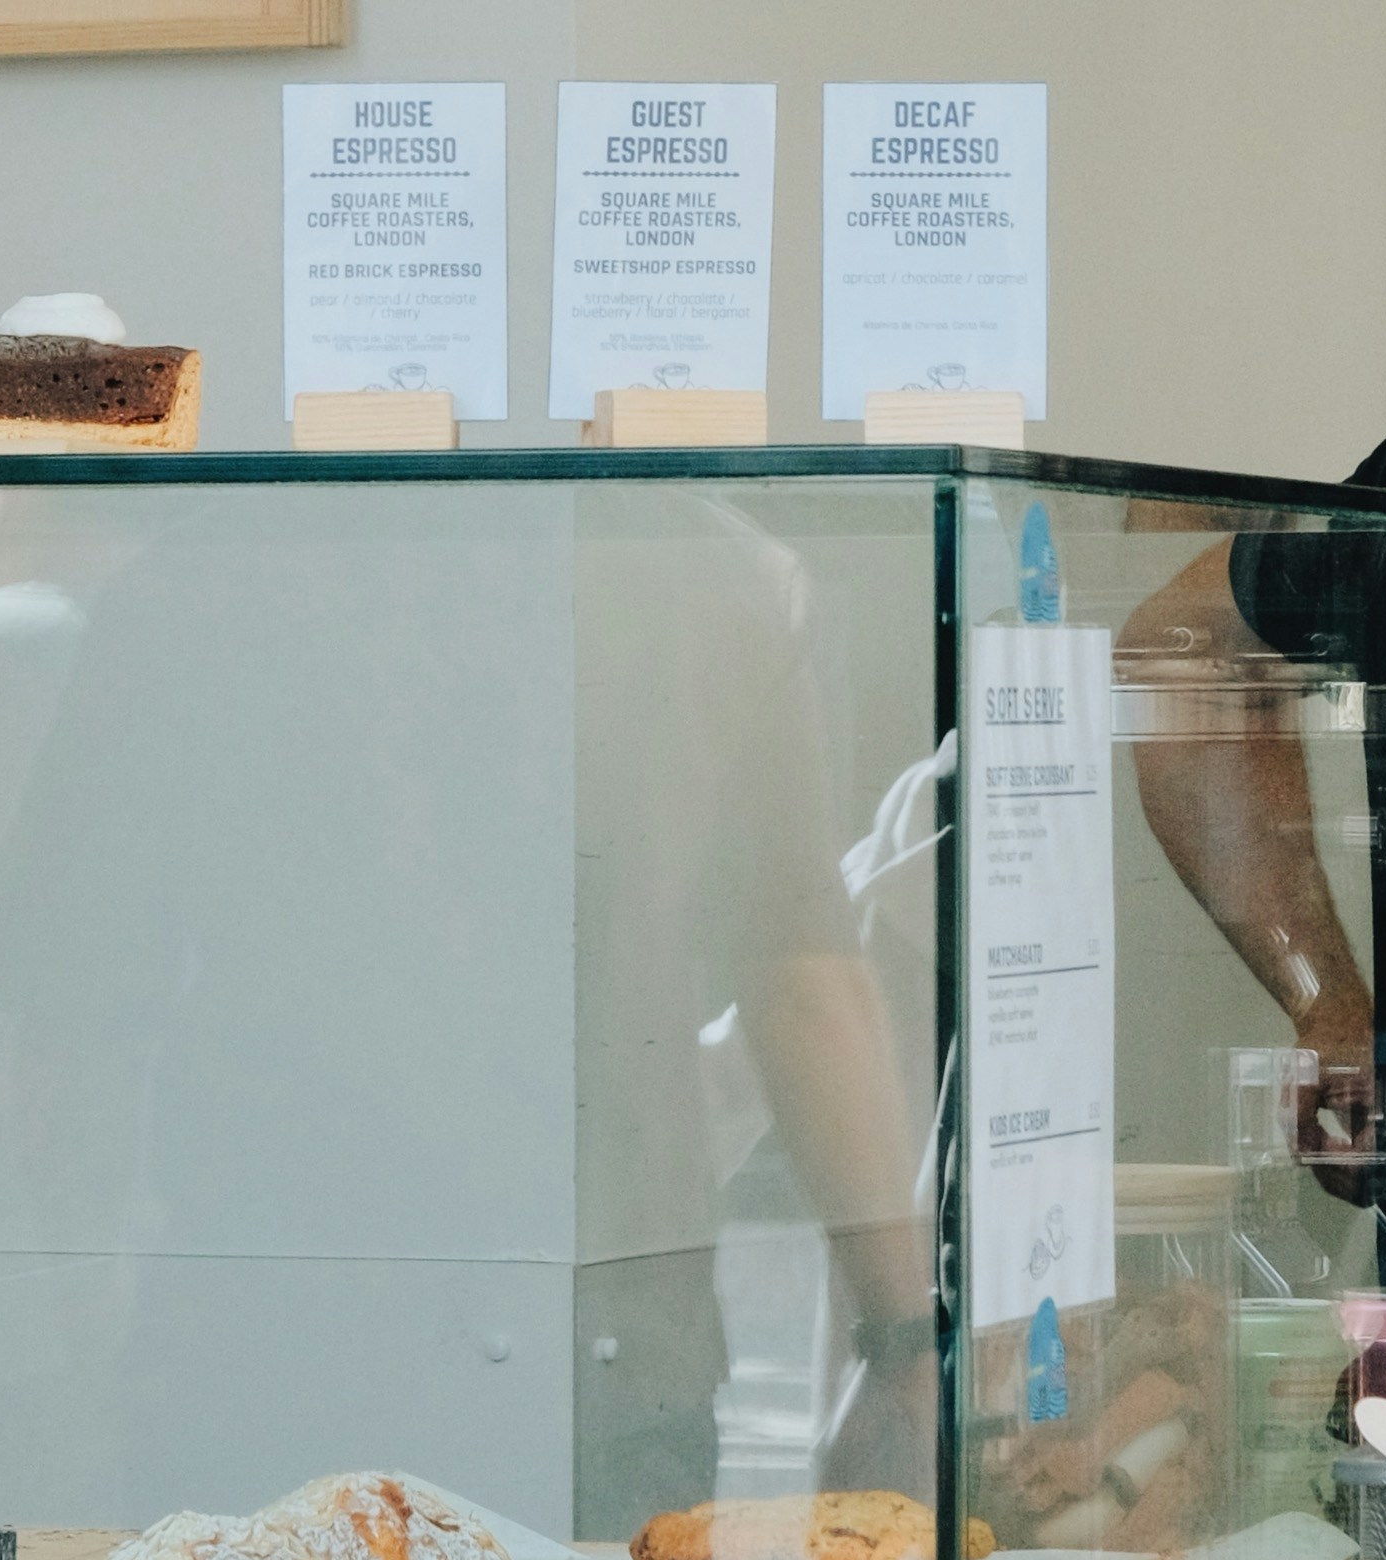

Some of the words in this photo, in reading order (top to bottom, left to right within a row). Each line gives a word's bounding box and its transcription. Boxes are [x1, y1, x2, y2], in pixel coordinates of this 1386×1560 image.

[355, 100, 433, 128] HOUSE
[631, 100, 707, 128] GUEST
[894, 100, 976, 129] DECAF
[332, 136, 457, 165] ESPRESSO
[606, 136, 728, 164] ESPRESSO
[871, 137, 999, 165] ESPRESSO
[330, 192, 401, 211] SQUARE
[407, 192, 449, 208] MILE
[601, 191, 671, 211] SQUARE
[676, 192, 716, 209] MILE
[870, 192, 942, 211] SQUARE
[948, 192, 990, 209] MILE
[307, 211, 370, 229] COFFEE
[376, 210, 474, 229] ROASTERS,
[578, 209, 642, 227] COFFEE
[648, 210, 741, 228] ROASTERS,
[847, 211, 911, 228] COFFEE
[917, 210, 1015, 229] ROASTERS,
[354, 230, 426, 248] LONDON
[625, 230, 695, 247] LONDON
[894, 230, 966, 247] LONDON
[308, 263, 340, 280] RED
[344, 263, 393, 279] BRICK
[399, 262, 482, 278] ESPRESSO
[574, 258, 672, 275] SWEETSHOP
[675, 259, 756, 275] ESPRESSO
[842, 272, 887, 286] apricot
[901, 271, 961, 286] chocolate
[976, 273, 1028, 286] caramel
[309, 295, 338, 308] pear
[353, 292, 402, 306] almond
[415, 292, 477, 306] chocolate
[584, 291, 653, 309] strawberry
[666, 291, 726, 307] chocolate
[380, 306, 422, 322] cherry
[571, 304, 632, 321] blueberry
[691, 306, 751, 322] bergamot
[984, 685, 1018, 719] SOFT
[1023, 685, 1065, 719] SERVE
[1010, 766, 1032, 786] SERVE
